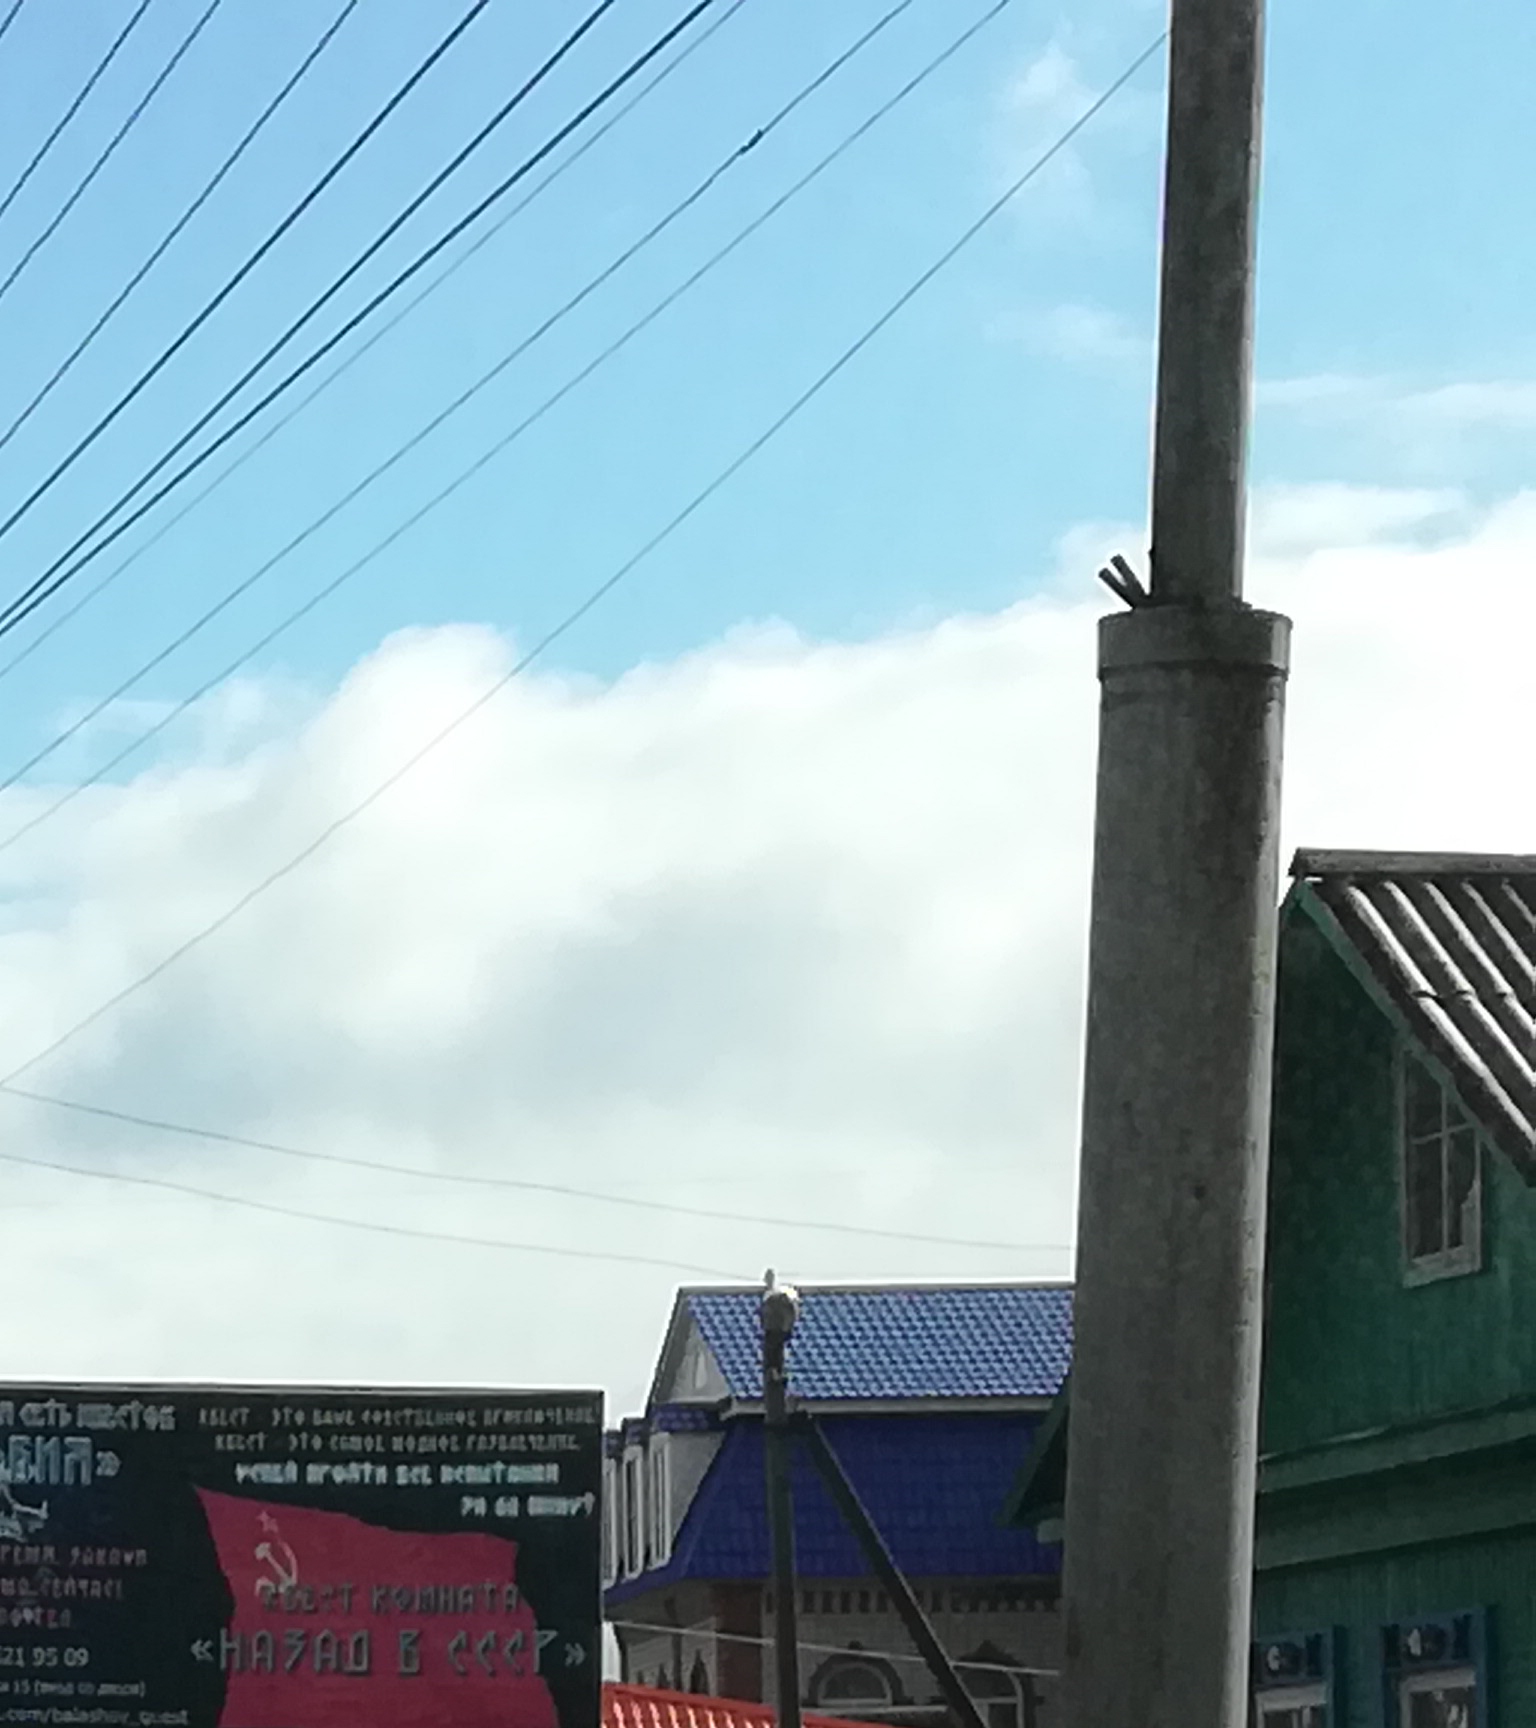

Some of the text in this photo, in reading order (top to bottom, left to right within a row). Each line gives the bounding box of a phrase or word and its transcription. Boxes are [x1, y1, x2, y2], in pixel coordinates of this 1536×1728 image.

[370, 1581, 520, 1615] КОМНАТА
[63, 1647, 91, 1668] 09
[398, 1629, 424, 1674] В
